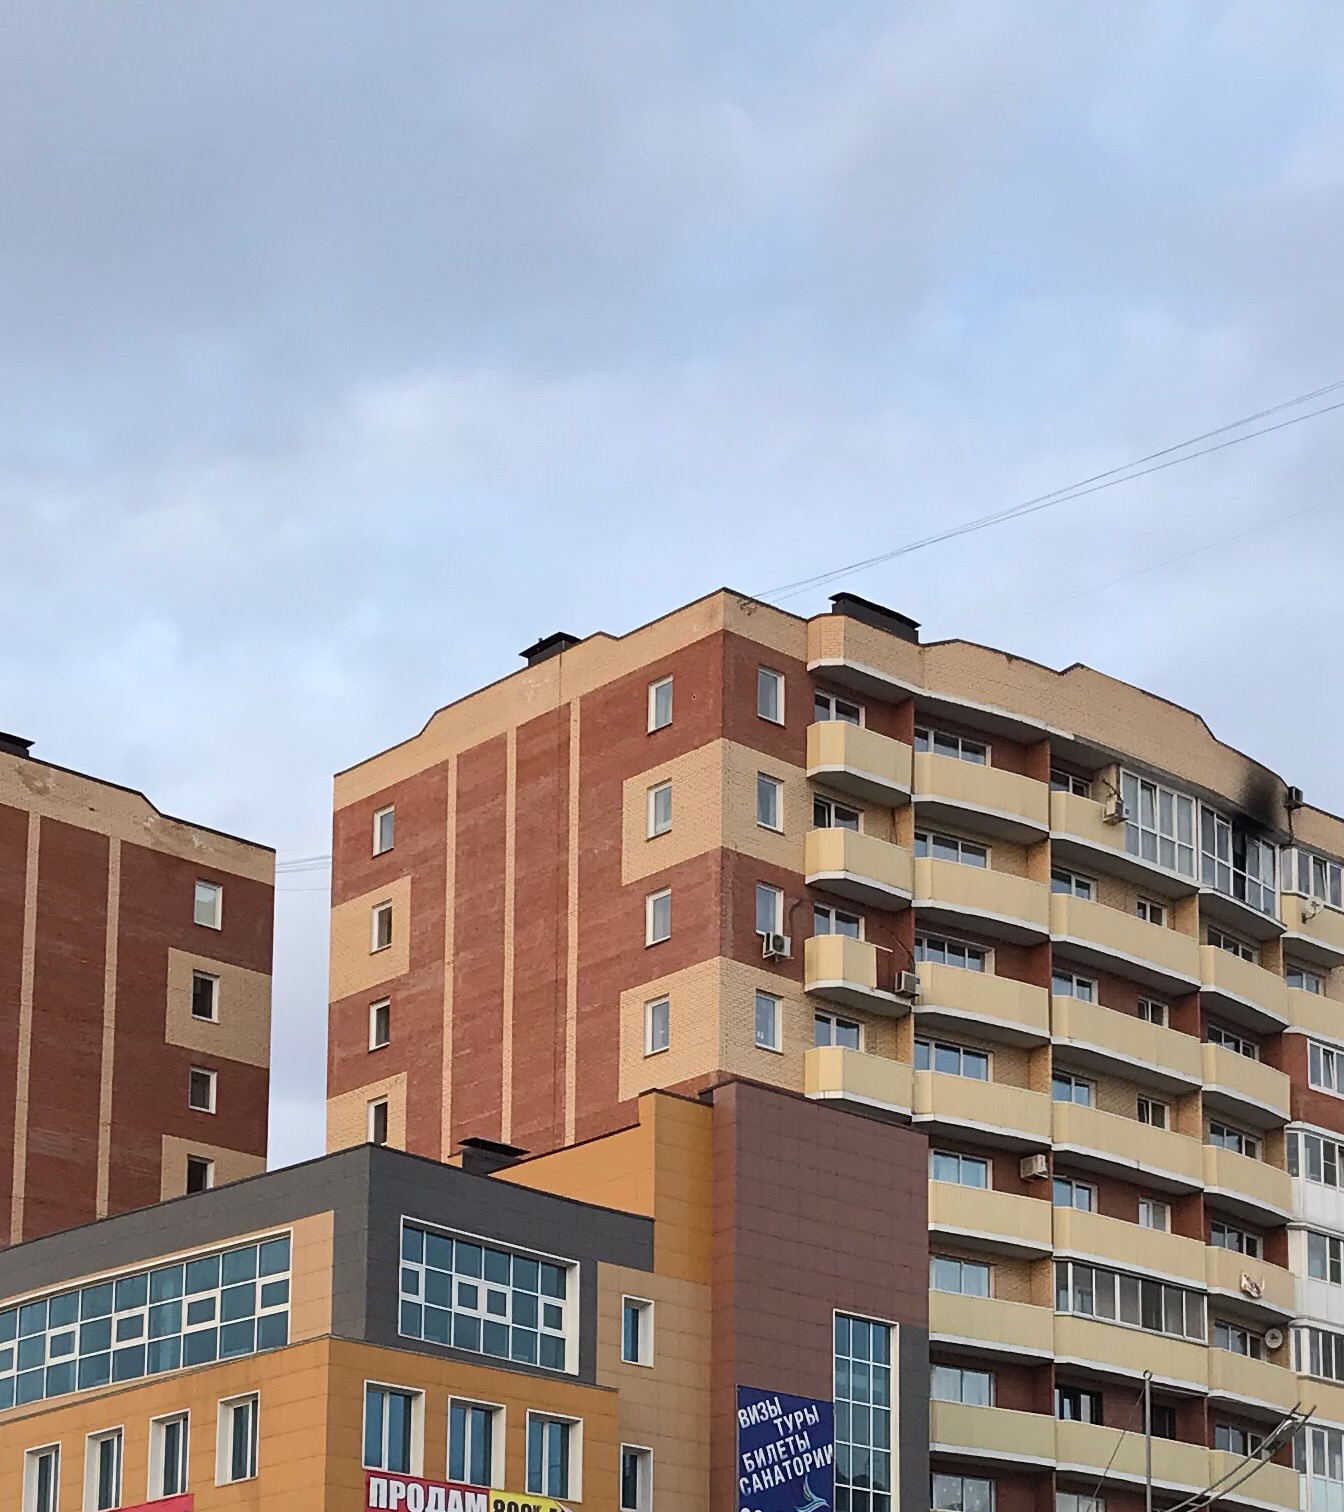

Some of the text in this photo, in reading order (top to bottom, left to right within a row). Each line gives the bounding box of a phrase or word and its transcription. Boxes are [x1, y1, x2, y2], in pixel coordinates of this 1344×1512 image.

[738, 1396, 782, 1429] ВИЗЫ
[773, 1405, 820, 1436] ТУРЫ
[739, 1443, 833, 1497] САНАТОРИИ
[742, 1431, 811, 1473] БИЛЕТЫ
